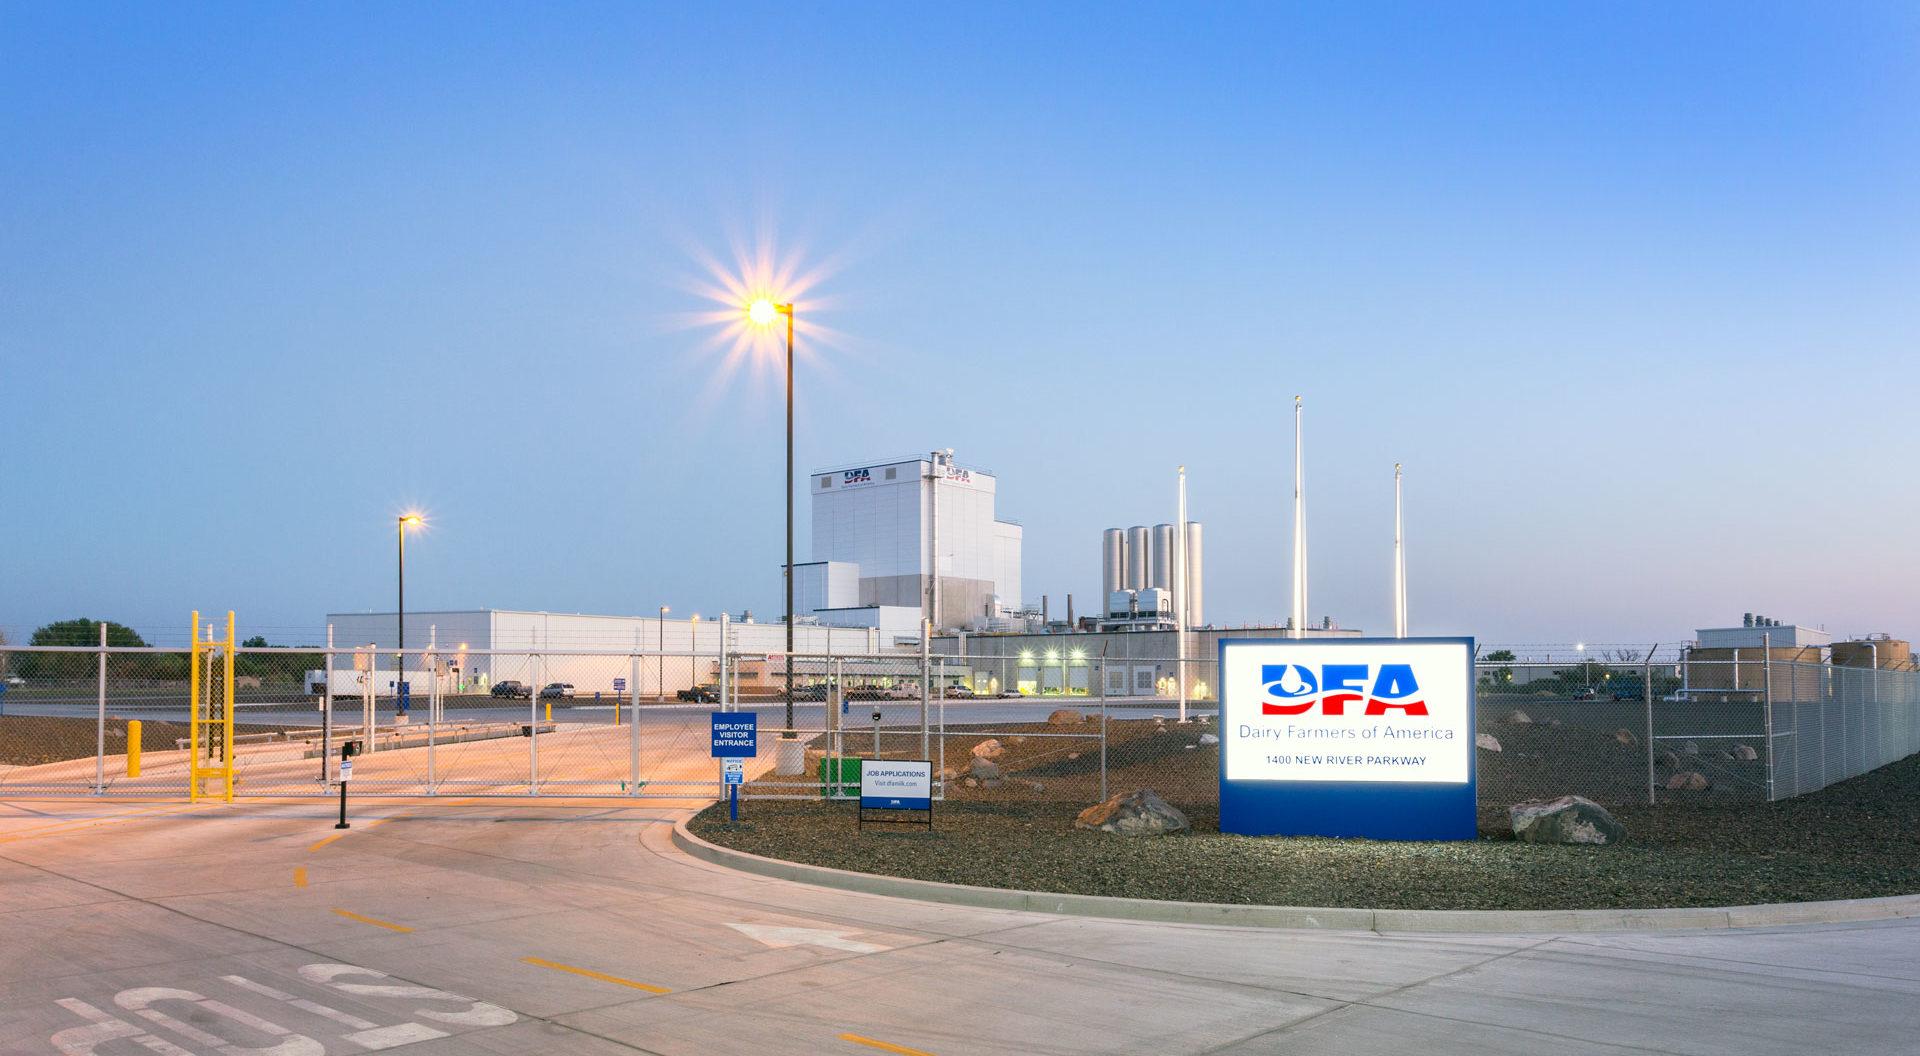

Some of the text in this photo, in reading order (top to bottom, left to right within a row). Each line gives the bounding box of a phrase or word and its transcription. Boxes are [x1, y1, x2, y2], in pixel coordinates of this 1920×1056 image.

[844, 469, 871, 484] DFA
[1262, 664, 1430, 716] DFA
[713, 723, 754, 731] EMPLOYEE
[719, 731, 749, 739] VISITOR
[1239, 725, 1454, 741] Dairy Farmers of America
[713, 739, 754, 747] ENTRANCE
[1266, 755, 1427, 766] 1400 NEW RIVER PARKWAY
[880, 770, 926, 778] APPLICATIONS
[50, 963, 518, 1056] STOP
